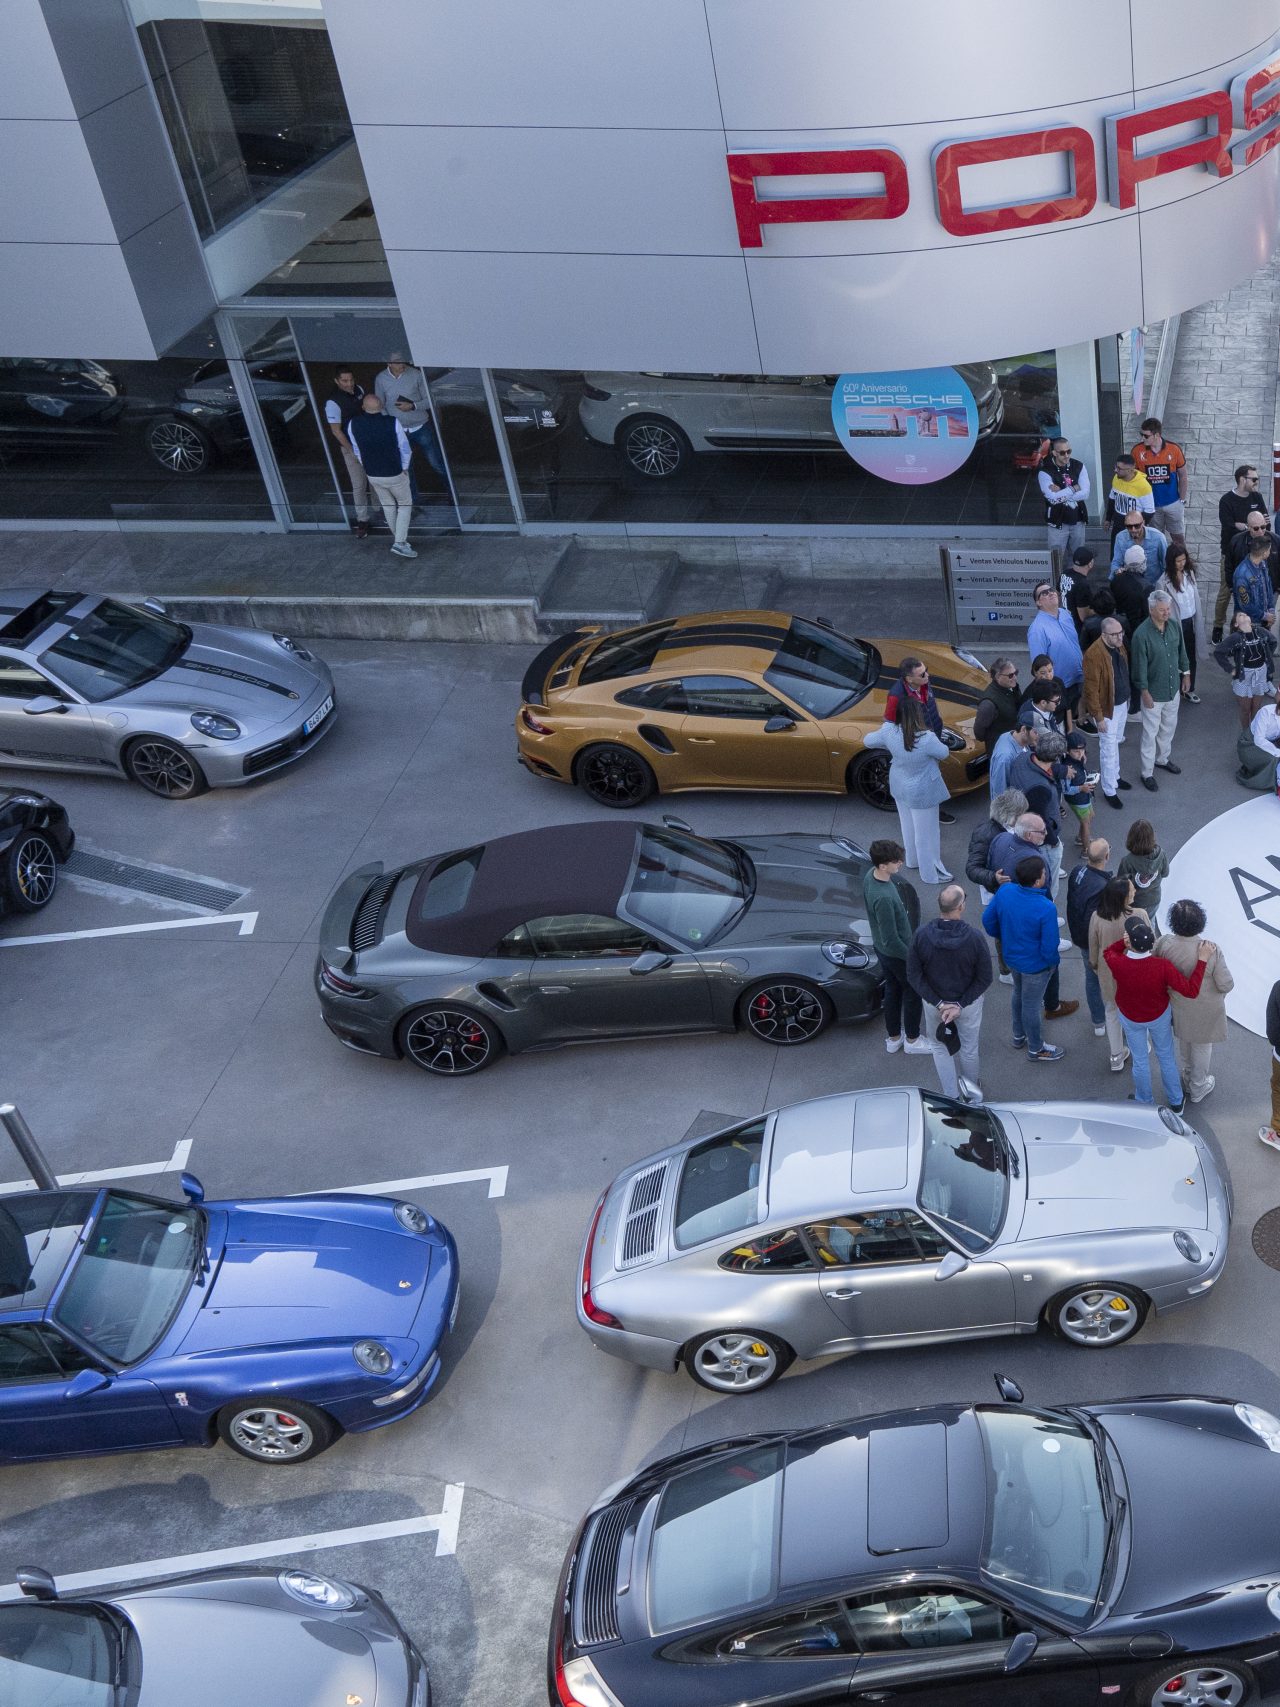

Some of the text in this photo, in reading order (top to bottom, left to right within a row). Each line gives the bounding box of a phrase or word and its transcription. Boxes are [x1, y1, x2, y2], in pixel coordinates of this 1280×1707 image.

[860, 383, 908, 393] Aniversario
[843, 394, 963, 404] PORSCHE
[845, 405, 970, 438] 911
[1148, 466, 1168, 477] 036
[969, 557, 992, 565] Ventas
[1024, 558, 1049, 566] Nuevos
[993, 576, 1020, 584] Porsche
[1020, 576, 1051, 585] Approved
[999, 613, 1023, 621] Parking
[184, 662, 270, 689] PORSCHE
